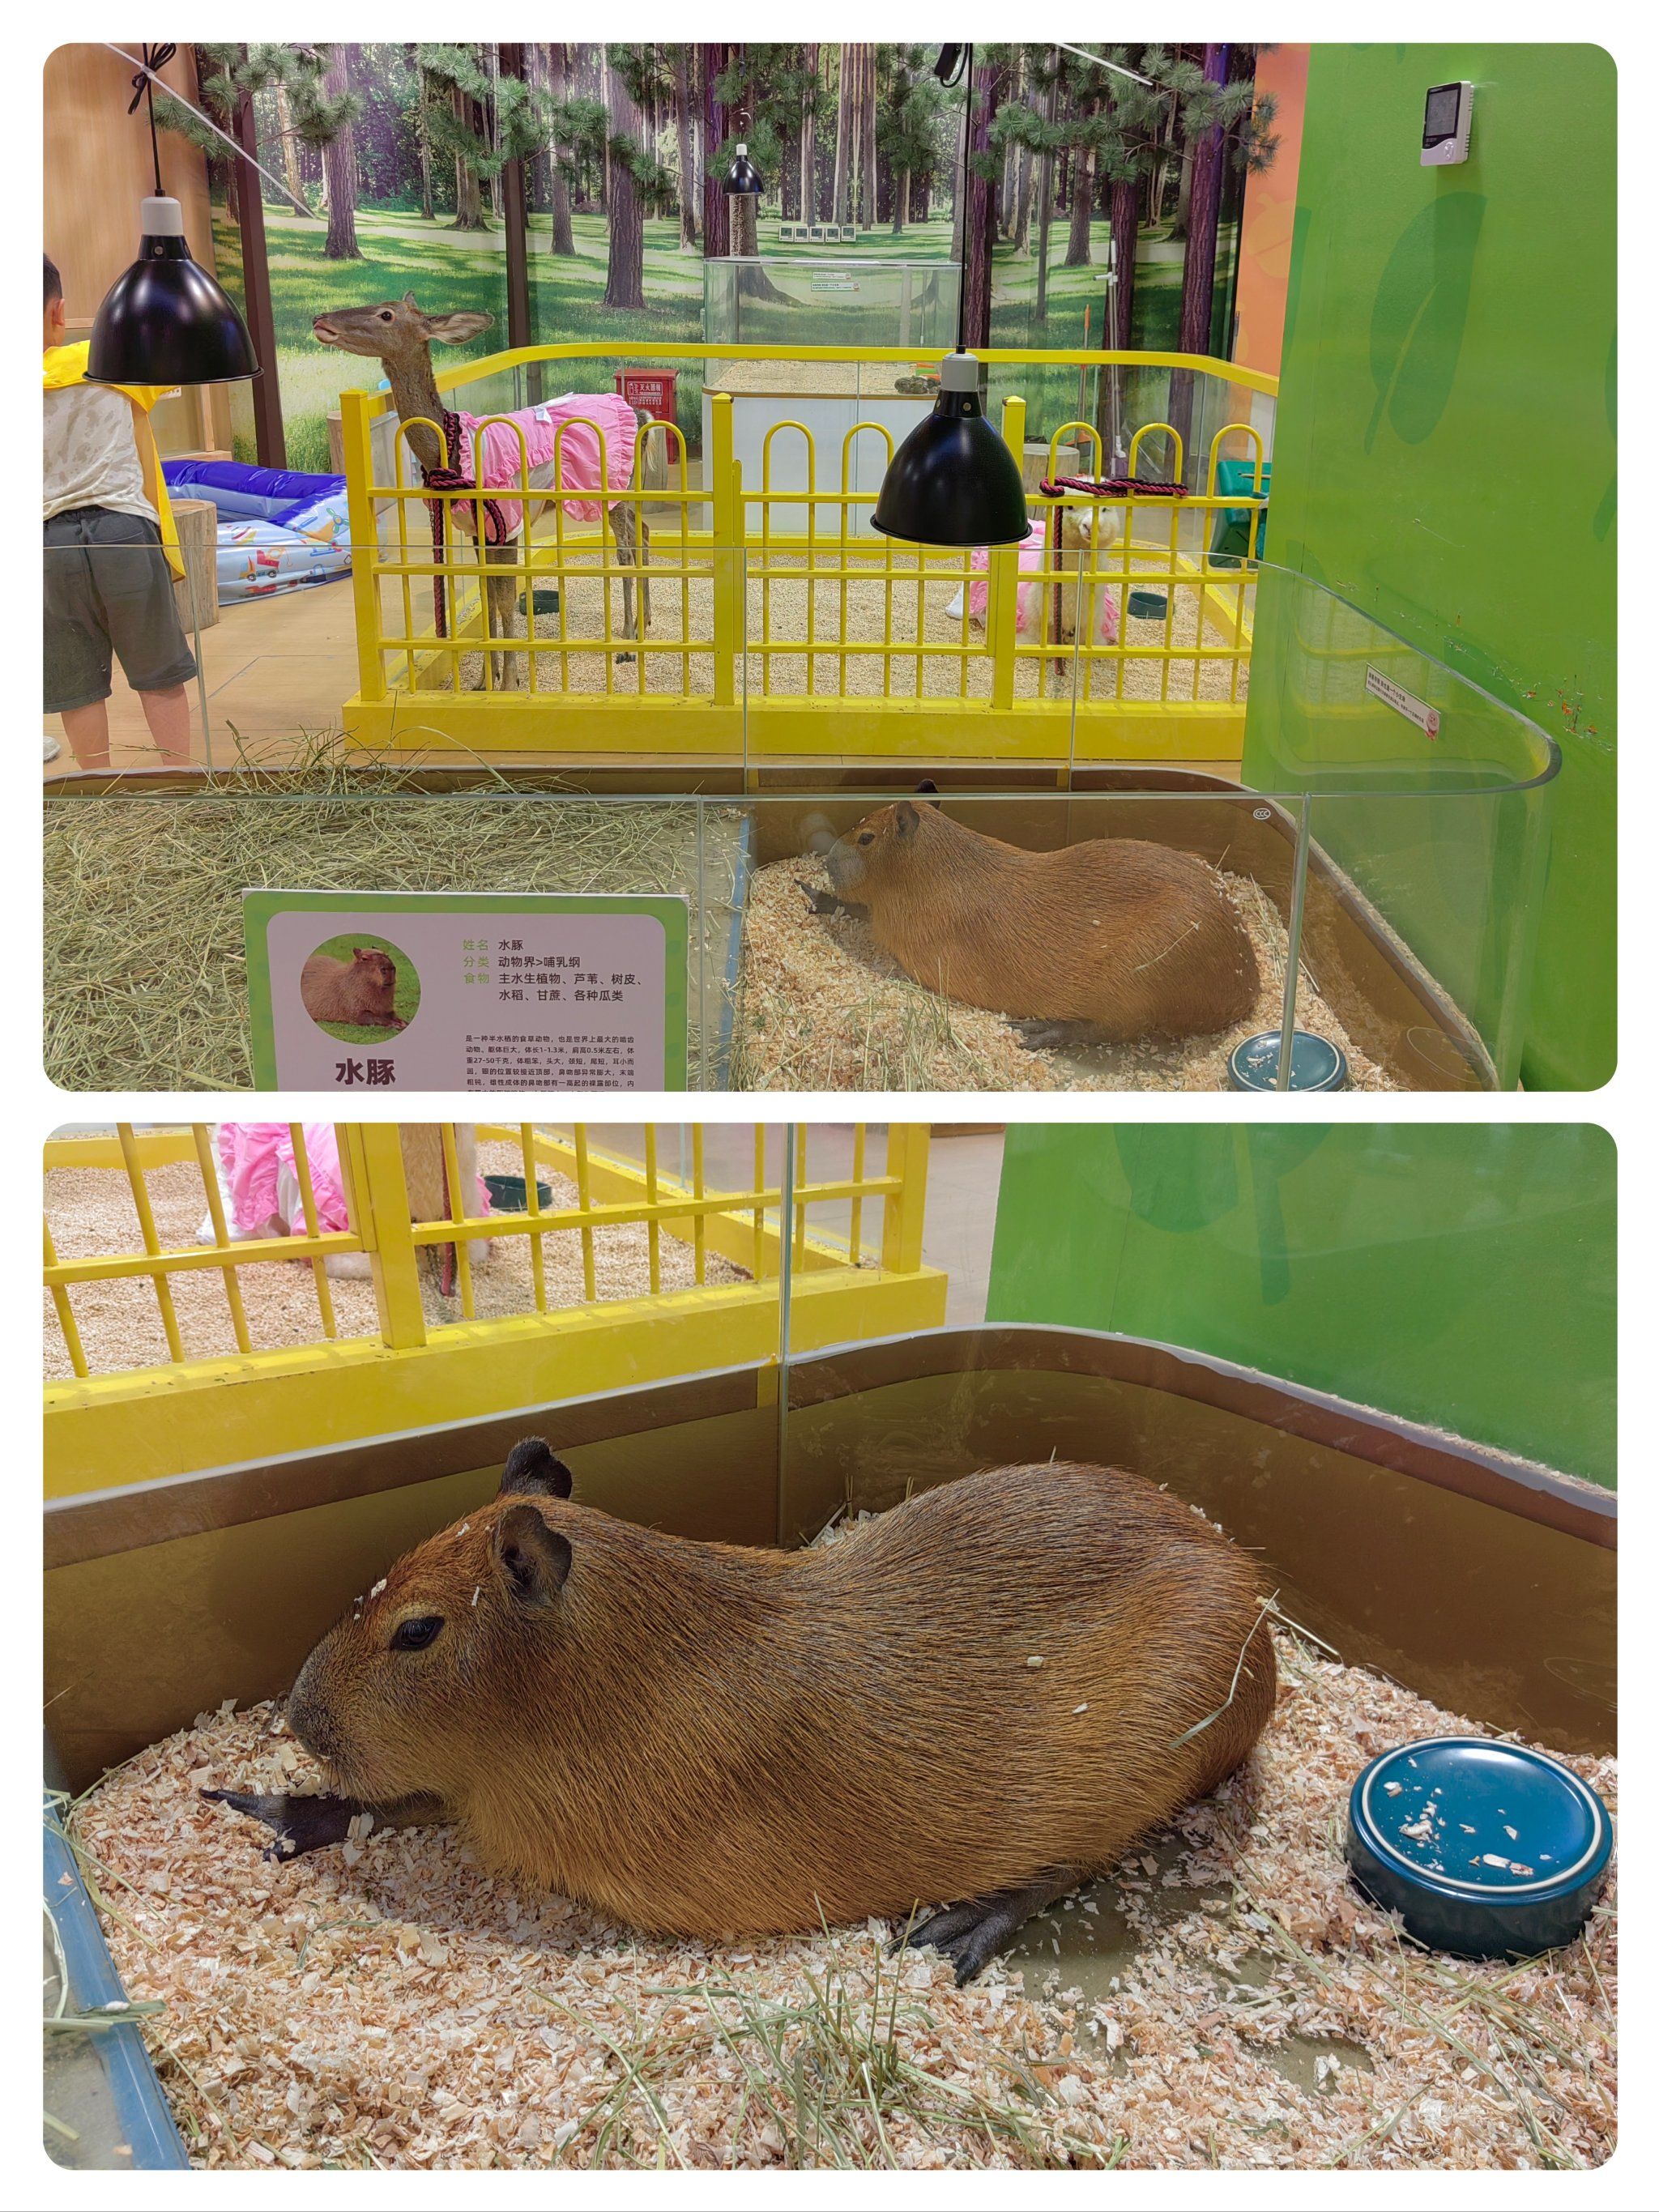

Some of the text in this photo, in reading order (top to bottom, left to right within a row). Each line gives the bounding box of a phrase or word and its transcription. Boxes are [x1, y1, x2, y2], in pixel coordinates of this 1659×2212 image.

[463, 939, 523, 951] 姓名 水豚
[463, 956, 581, 968] 分类 动物界>哺乳纲
[463, 973, 642, 985] 食物 主水生植物、芦苇、树皮、
[499, 989, 624, 1002] 水稻、甘蔗、各种瓜类
[335, 1058, 396, 1085] 水豚
